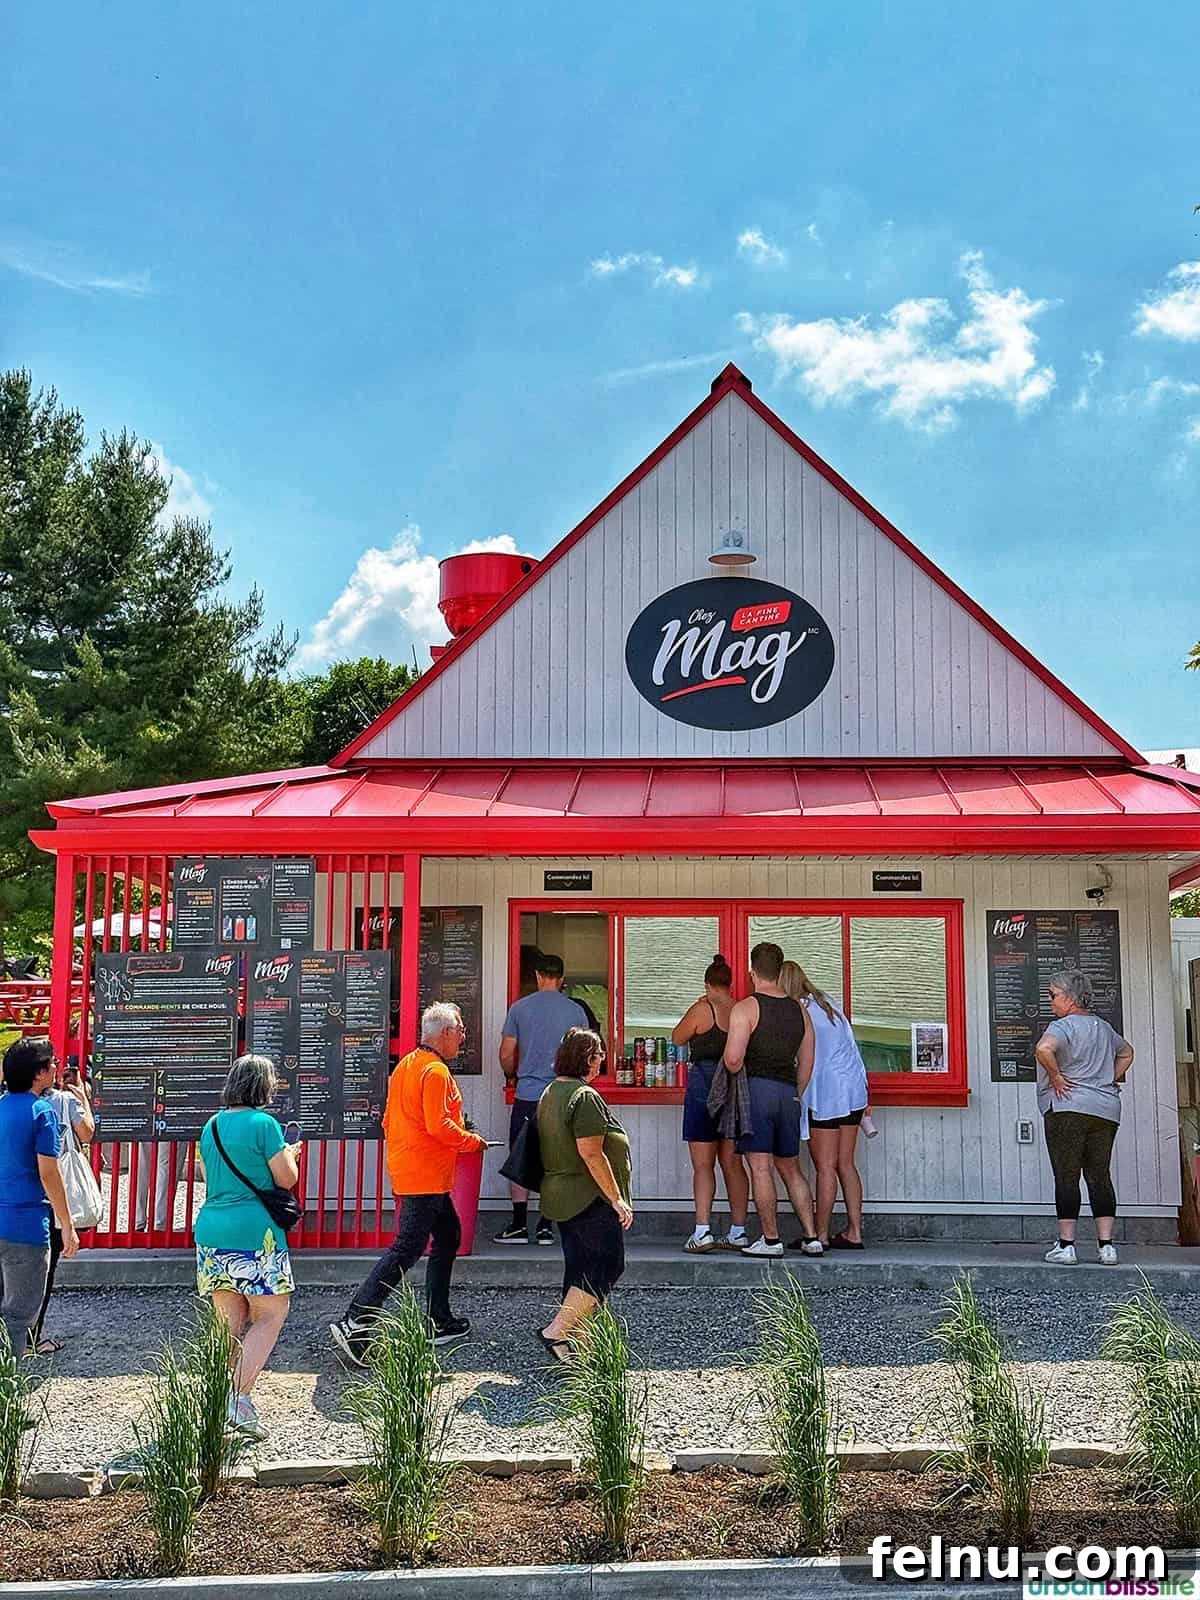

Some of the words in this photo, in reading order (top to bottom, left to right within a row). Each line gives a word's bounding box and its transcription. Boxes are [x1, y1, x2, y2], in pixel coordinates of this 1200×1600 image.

[688, 608, 716, 625] Chez
[756, 607, 780, 617] FINE
[739, 612, 780, 625] CANTINE
[808, 627, 820, 635] MC
[652, 619, 808, 704] Mag
[180, 864, 208, 883] Mag
[993, 919, 1029, 940] Mag
[205, 958, 235, 976] Mag
[254, 959, 294, 983] Mag
[98, 1014, 102, 1024] 1
[96, 1034, 104, 1044] 2
[96, 1054, 103, 1062] 3
[94, 1070, 102, 1080] 4
[158, 1070, 165, 1080] 7
[94, 1098, 100, 1106] 5
[156, 1104, 164, 1113] 9
[156, 1121, 166, 1130] 10
